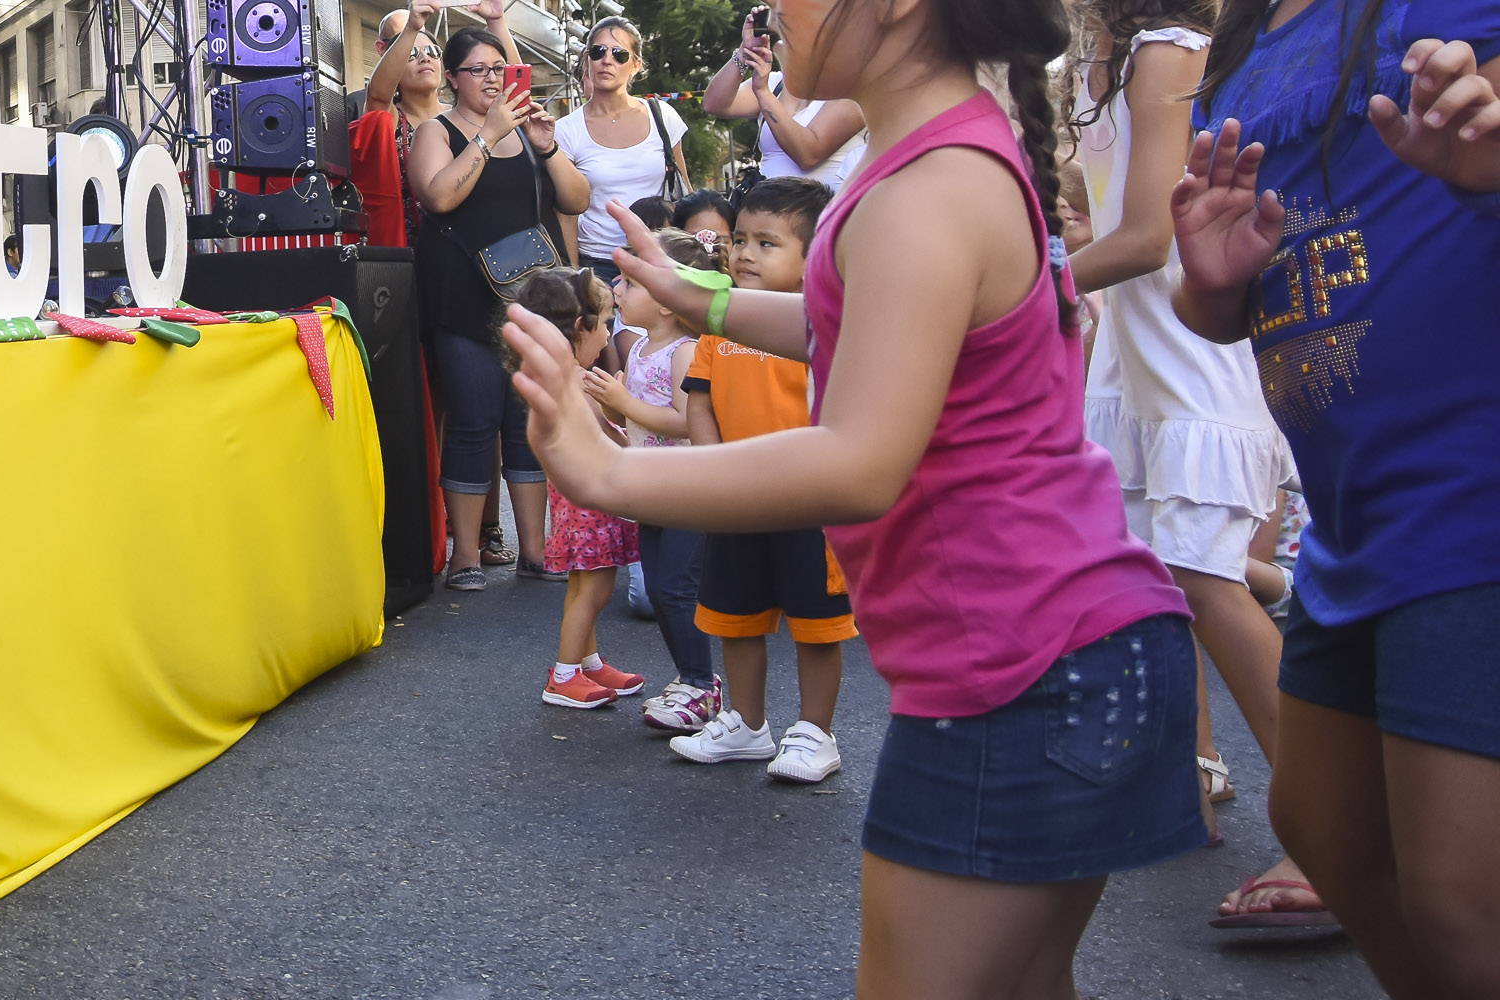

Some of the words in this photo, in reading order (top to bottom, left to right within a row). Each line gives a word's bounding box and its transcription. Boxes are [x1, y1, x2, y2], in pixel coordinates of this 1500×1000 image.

[301, 23, 311, 46] M18
[306, 126, 317, 149] M18
[716, 340, 794, 362] Champ
